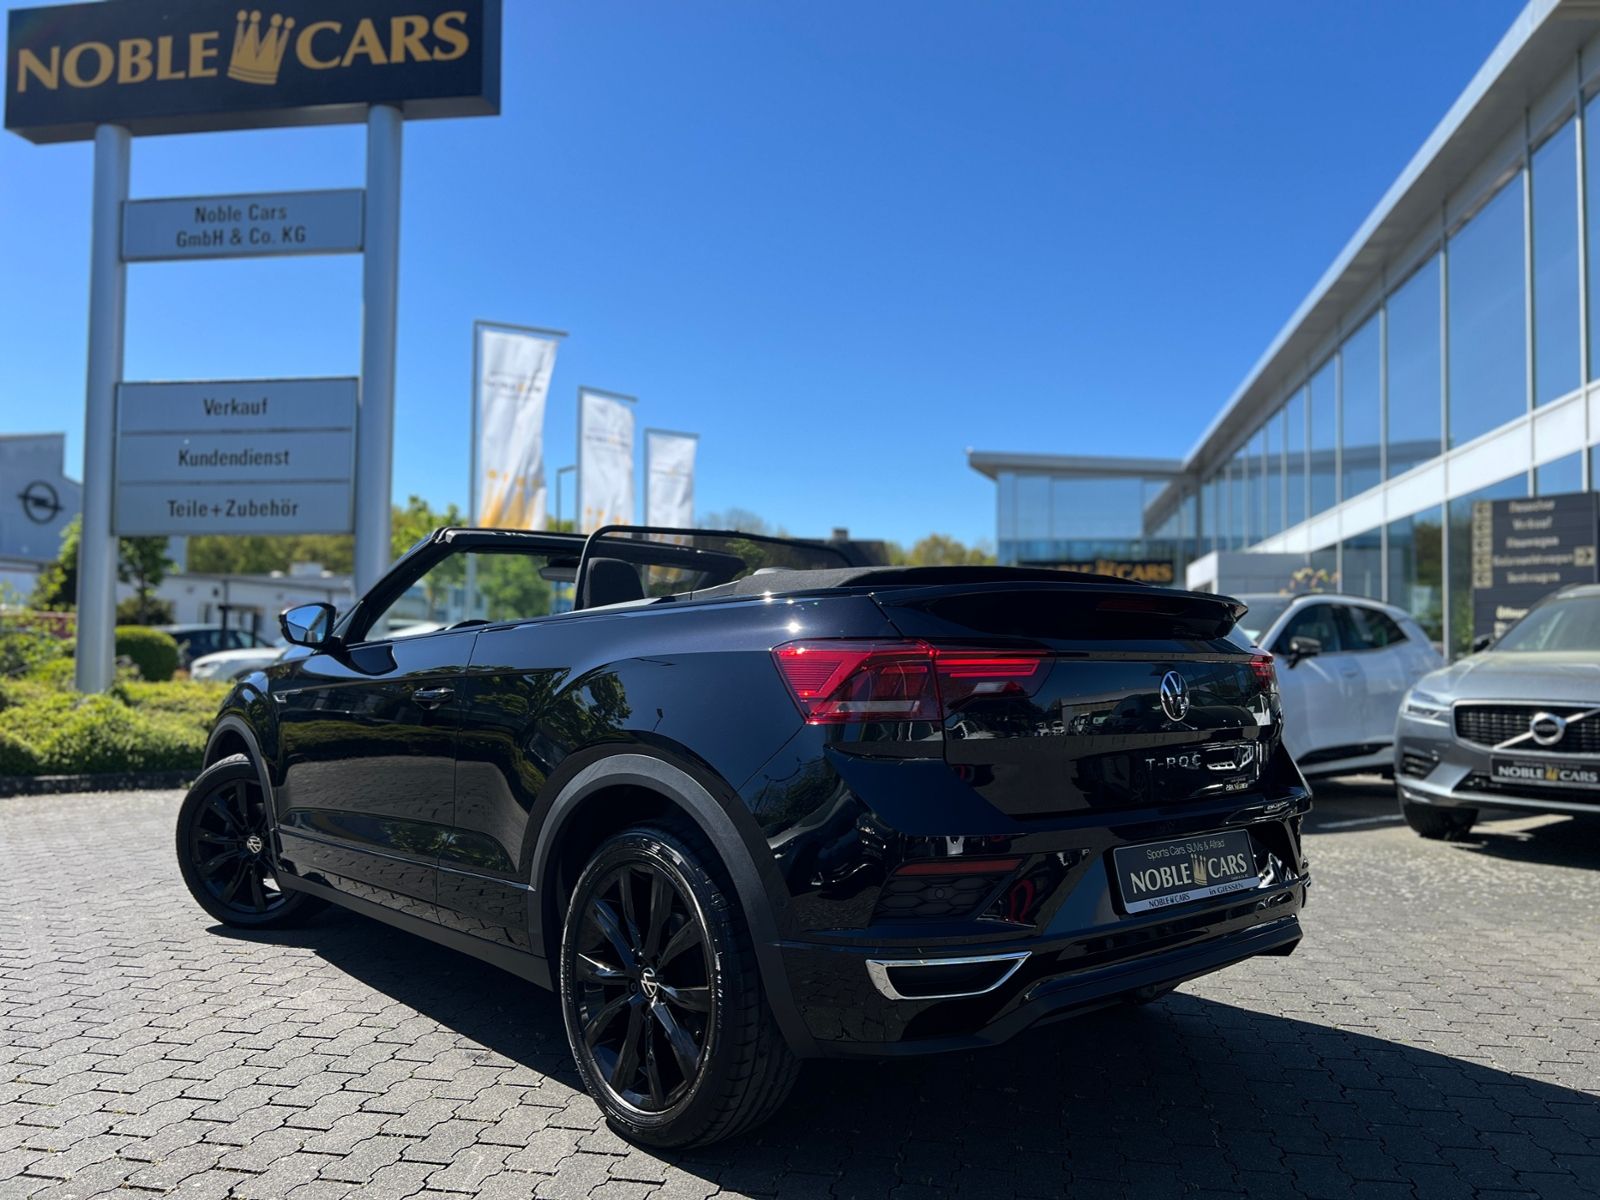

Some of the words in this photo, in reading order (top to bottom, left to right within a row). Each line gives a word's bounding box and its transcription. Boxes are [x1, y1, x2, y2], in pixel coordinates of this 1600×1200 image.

[17, 31, 219, 93] NOBLE
[296, 11, 470, 69] CARS
[194, 205, 242, 223] Noble
[248, 203, 287, 221] Cars
[176, 229, 224, 248] GmbH
[230, 227, 242, 246] &
[249, 226, 276, 245] Co.
[281, 225, 307, 243] KG
[203, 397, 268, 416] Verkauf
[178, 449, 290, 467] Kundendienst
[1498, 765, 1544, 779] NOBLE
[1559, 770, 1598, 783] CARS
[1146, 848, 1170, 861] Sports
[1130, 863, 1192, 894] NOBLE
[1207, 853, 1248, 879] CARS
[1148, 896, 1171, 908] NOBLE
[1174, 892, 1191, 904] CARS
